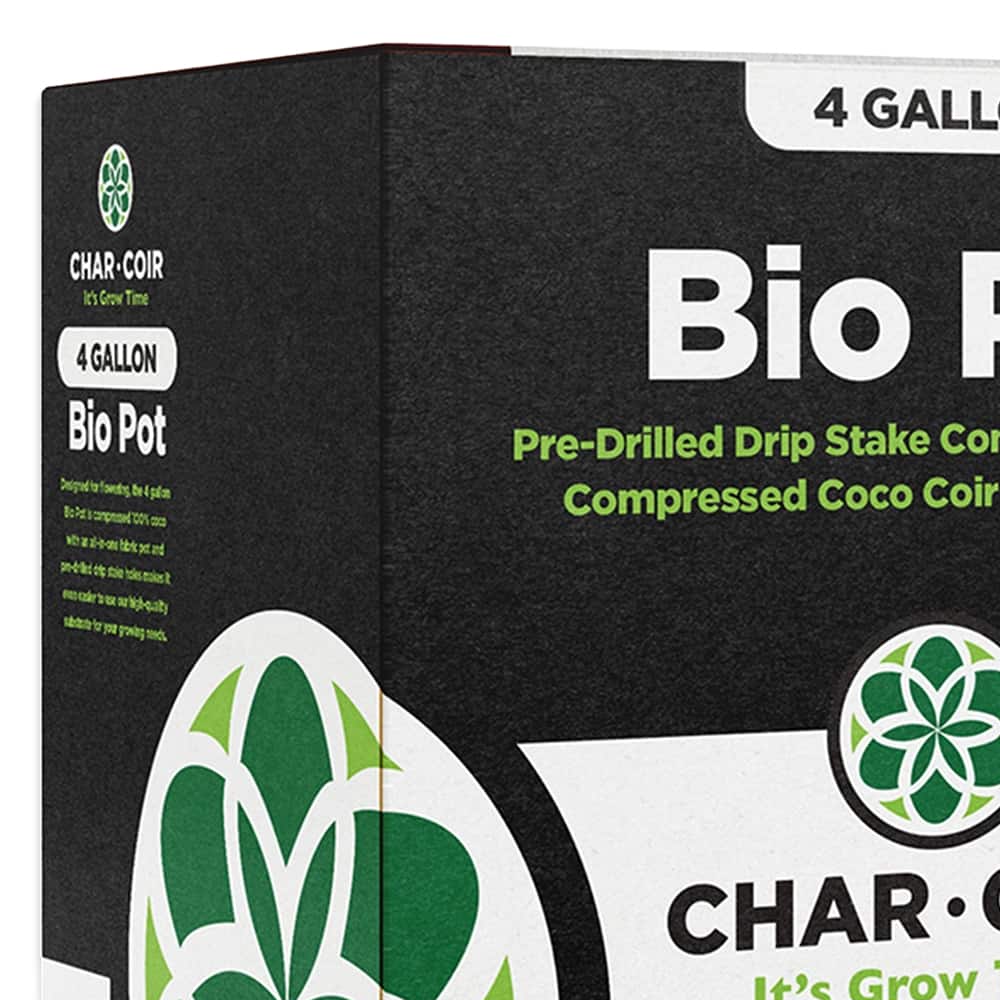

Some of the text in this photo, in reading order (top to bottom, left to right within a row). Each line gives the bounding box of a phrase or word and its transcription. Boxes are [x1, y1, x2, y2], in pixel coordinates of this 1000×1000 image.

[813, 87, 848, 127] 4
[69, 249, 164, 281] CHAR COIR
[100, 290, 123, 306] Grow
[125, 290, 149, 306] Time
[648, 244, 911, 382] Bio
[76, 342, 157, 373] 4 GALLON
[69, 398, 167, 457] Bio Pot
[513, 424, 724, 461] Pre-Drilled
[735, 424, 816, 464] Drip
[825, 422, 931, 457] Stake
[563, 478, 807, 520] Compressed
[817, 478, 913, 511] Coco
[922, 475, 999, 509] Coir
[666, 871, 930, 956] CHAR
